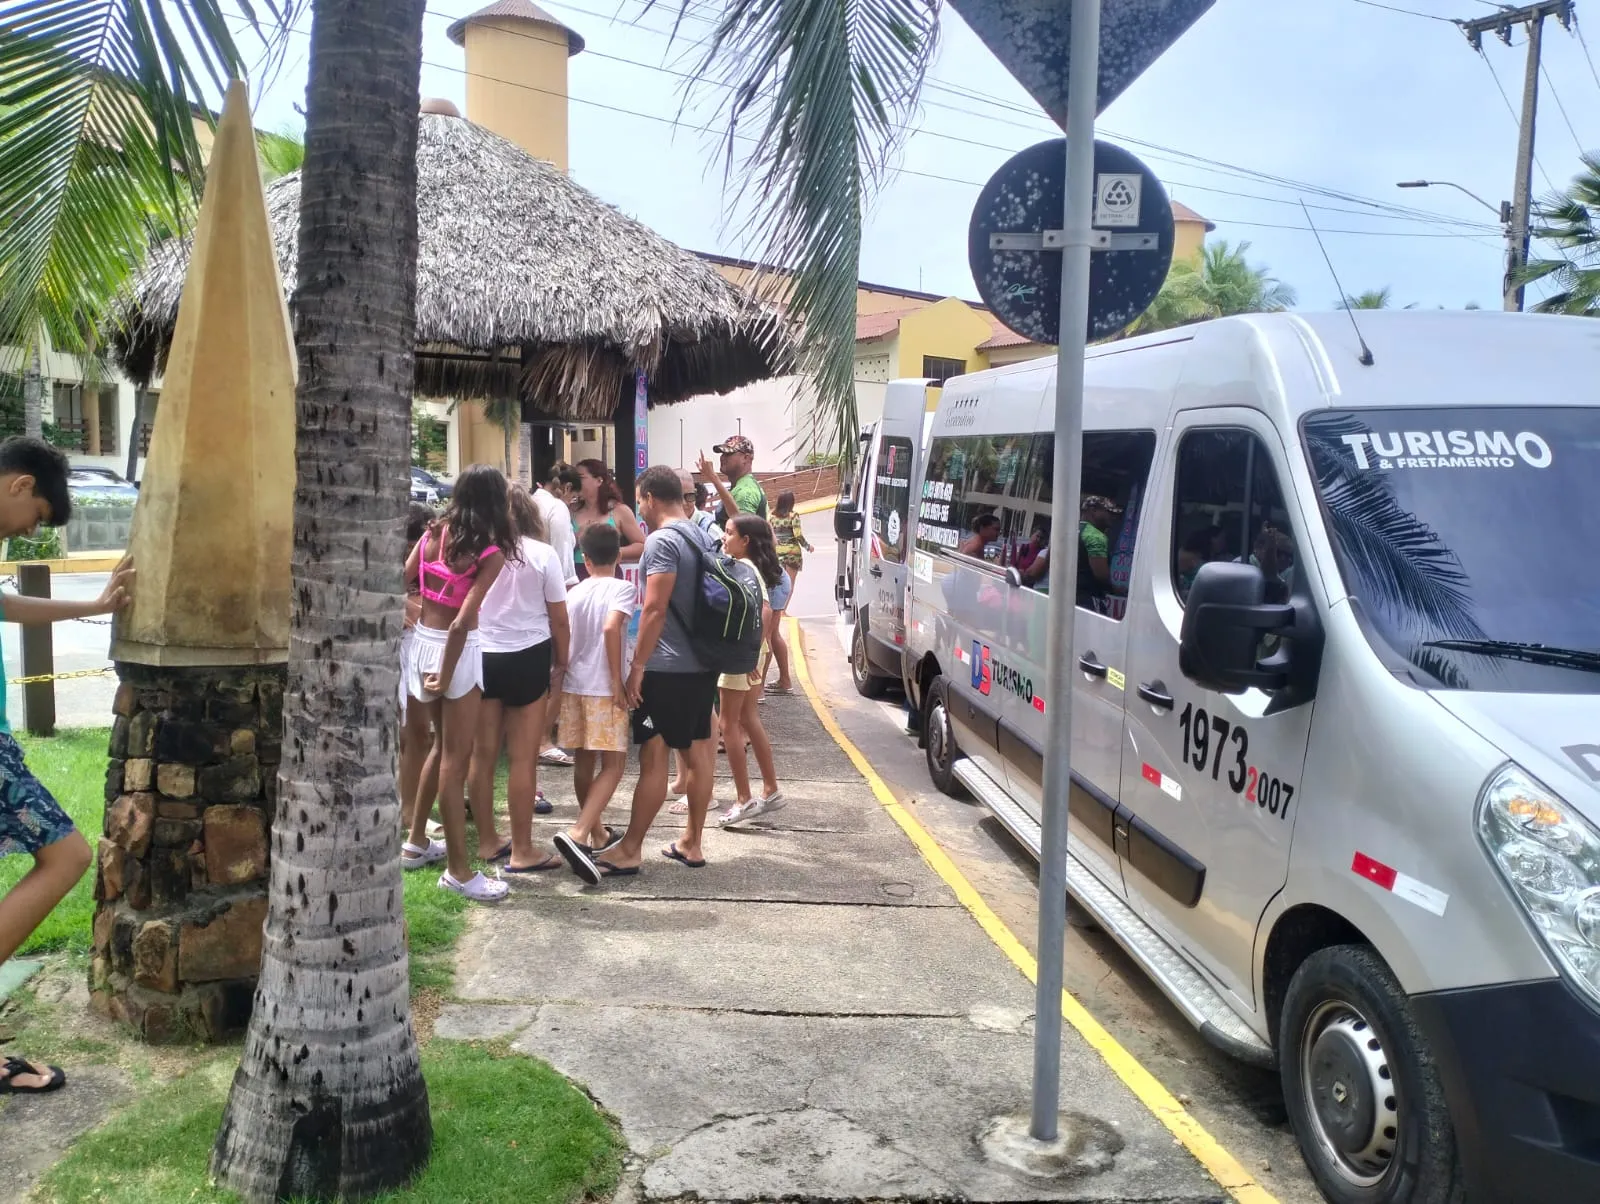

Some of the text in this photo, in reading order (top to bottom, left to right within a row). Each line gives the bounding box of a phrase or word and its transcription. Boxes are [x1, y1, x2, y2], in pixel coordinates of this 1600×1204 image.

[1341, 430, 1552, 470] TURISMO
[1379, 456, 1514, 469] & FRETAMENTO
[991, 658, 1033, 704] TURISMO
